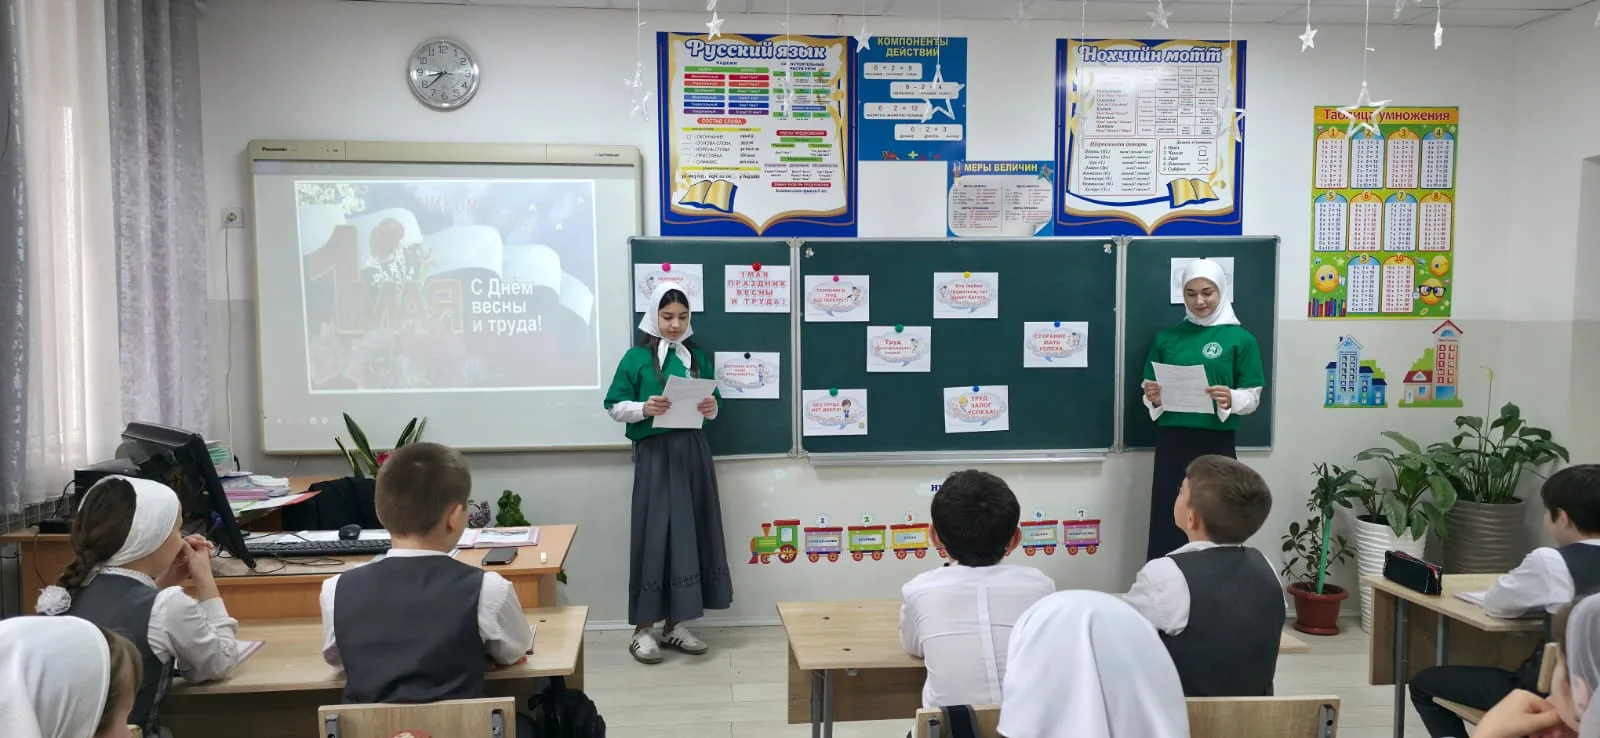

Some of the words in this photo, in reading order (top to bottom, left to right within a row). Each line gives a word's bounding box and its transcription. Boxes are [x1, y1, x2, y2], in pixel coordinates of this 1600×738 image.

[877, 37, 948, 47] КОМПОНЕНТЫ
[428, 48, 435, 57] 11
[439, 45, 448, 54] 12
[454, 49, 458, 57] 1
[685, 38, 774, 62] Русский
[775, 45, 827, 60] язык
[886, 47, 939, 58] ДЕЙСТВИЙ
[1077, 44, 1163, 63] Нохчийн
[1164, 46, 1223, 63] мотт
[418, 56, 427, 65] 10
[460, 57, 467, 65] 2
[416, 68, 423, 76] 9
[465, 69, 471, 78] 3
[421, 80, 428, 89] 8
[461, 81, 467, 89] 4
[429, 88, 436, 97] 7
[441, 92, 448, 100] 6
[453, 88, 460, 97] 5
[1378, 111, 1450, 123] умножения
[1330, 128, 1336, 136] 1
[1401, 128, 1407, 136] 3
[1436, 128, 1441, 136] 4
[964, 163, 991, 172] МЕРЫ
[994, 163, 1038, 172] ВЕЛИЧИН
[1364, 192, 1369, 200] 6
[1362, 254, 1367, 262] 9
[471, 278, 483, 296] С
[487, 277, 533, 299] Днём
[471, 300, 527, 314] весны
[472, 319, 483, 333] и
[487, 314, 543, 337] труда!
[884, 338, 902, 346] Труд
[1078, 510, 1084, 518] 7
